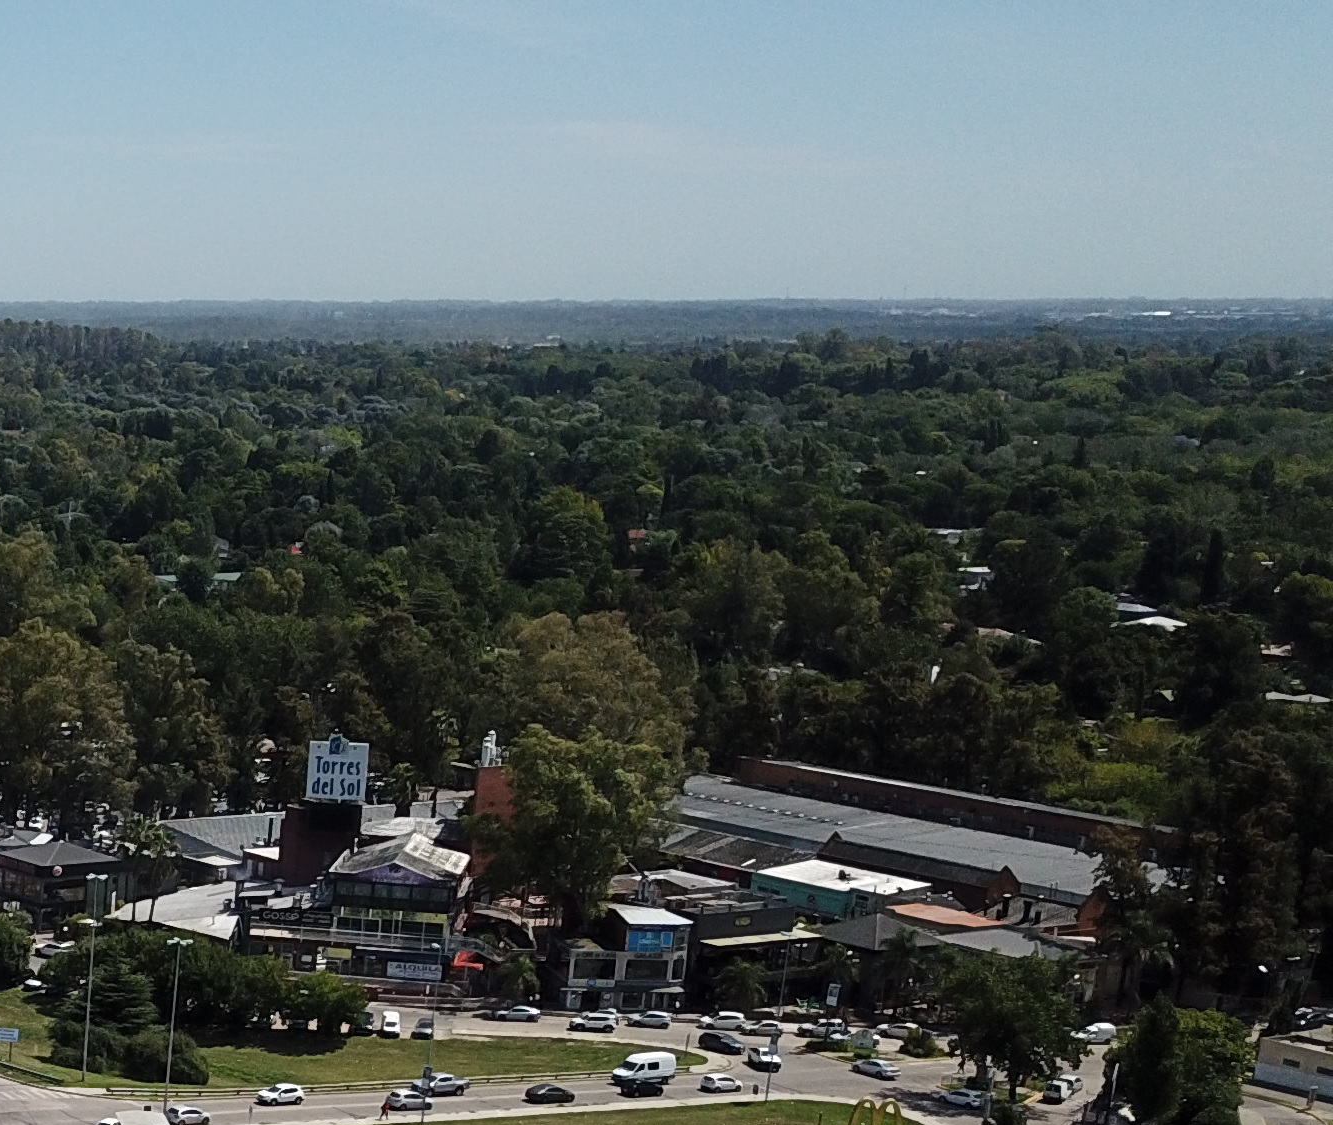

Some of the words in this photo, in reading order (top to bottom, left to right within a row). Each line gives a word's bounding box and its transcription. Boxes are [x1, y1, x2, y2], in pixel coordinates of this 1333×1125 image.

[315, 755, 361, 776] Torres
[311, 777, 334, 796] del
[339, 777, 361, 797] Sol
